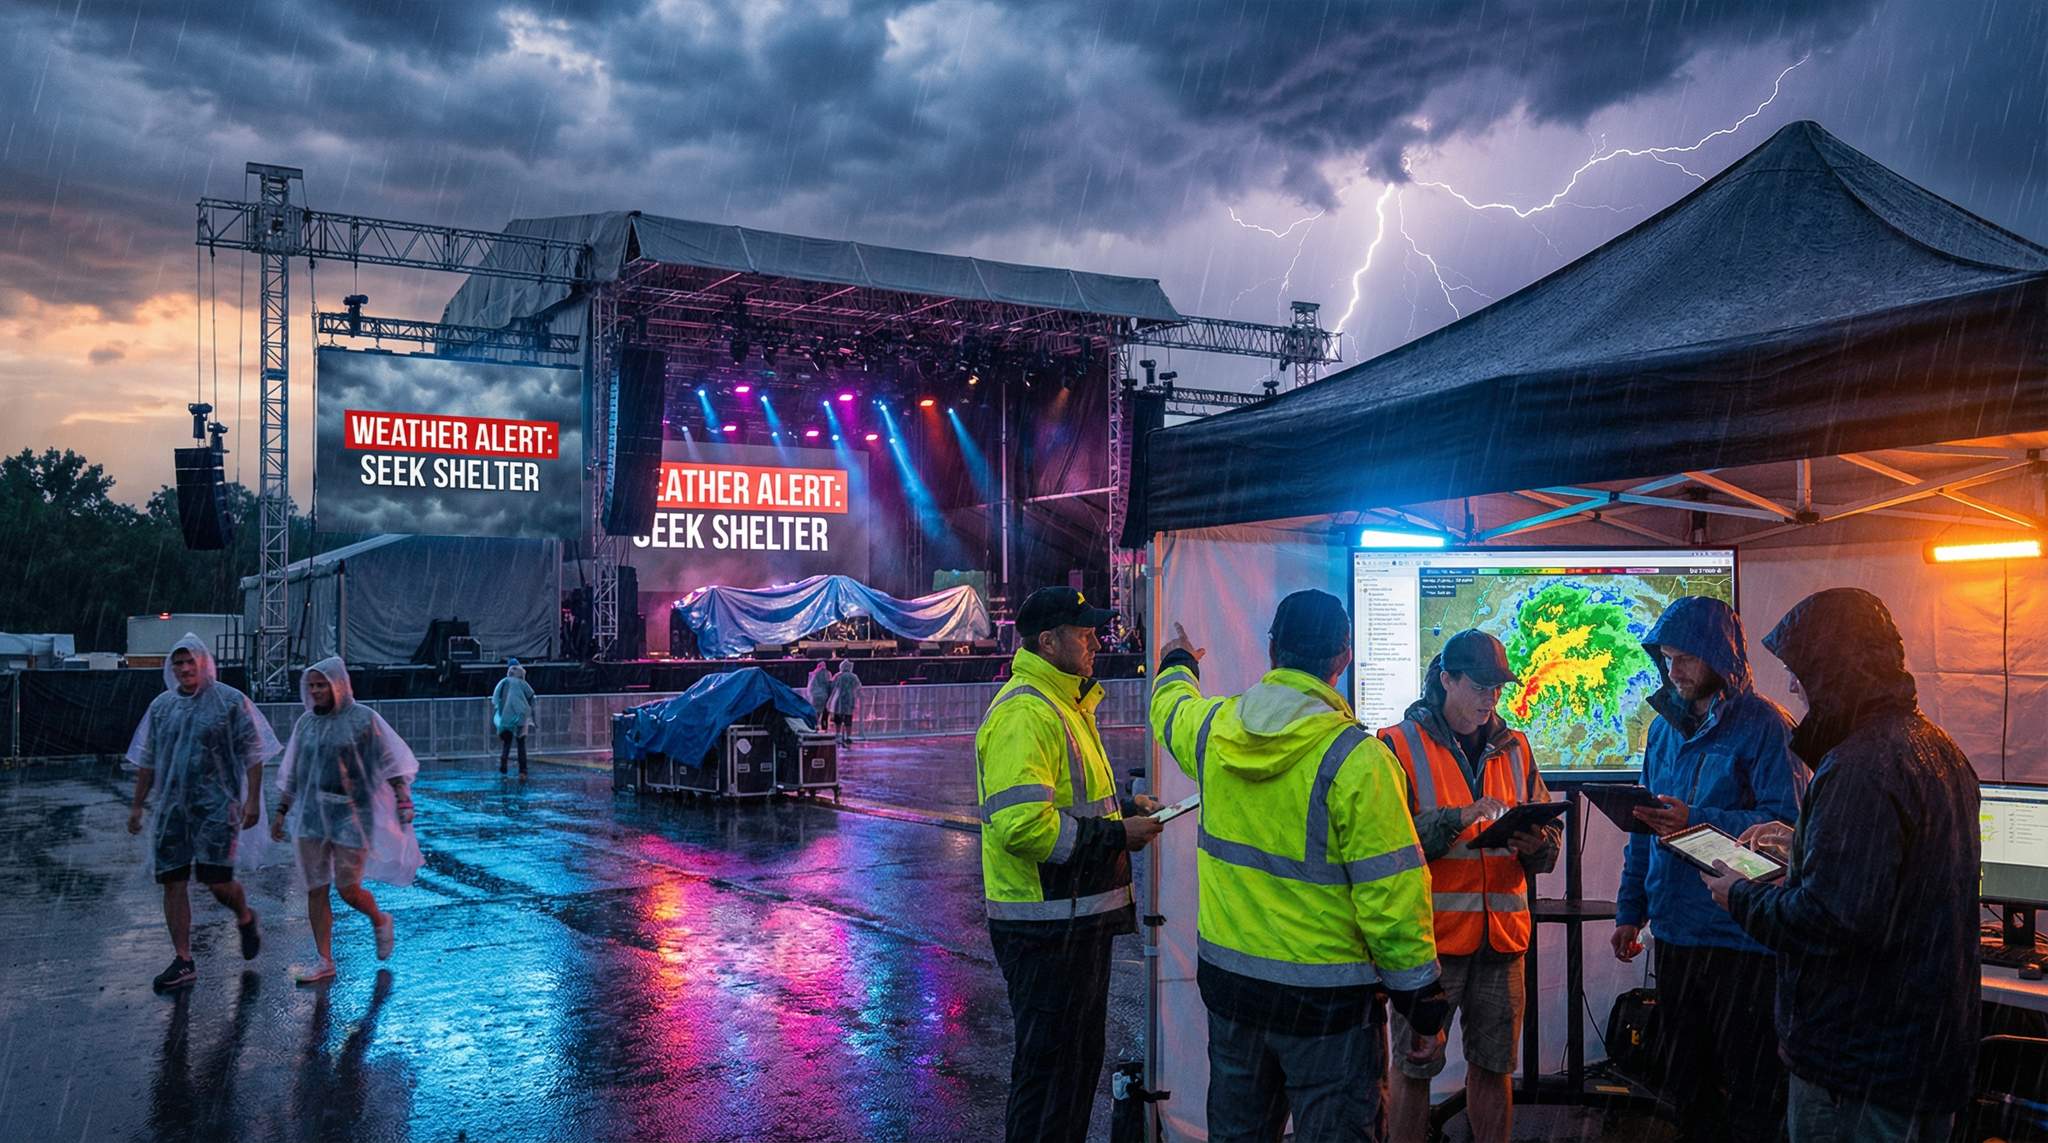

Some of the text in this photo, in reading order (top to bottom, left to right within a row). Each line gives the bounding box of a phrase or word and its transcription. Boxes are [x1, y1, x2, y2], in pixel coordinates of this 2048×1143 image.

[352, 415, 553, 454] WEATHER ALERT:
[360, 454, 540, 492] SEEK SHELTER
[656, 468, 841, 508] ATHER ALERT:
[712, 514, 828, 552] SHELTER
